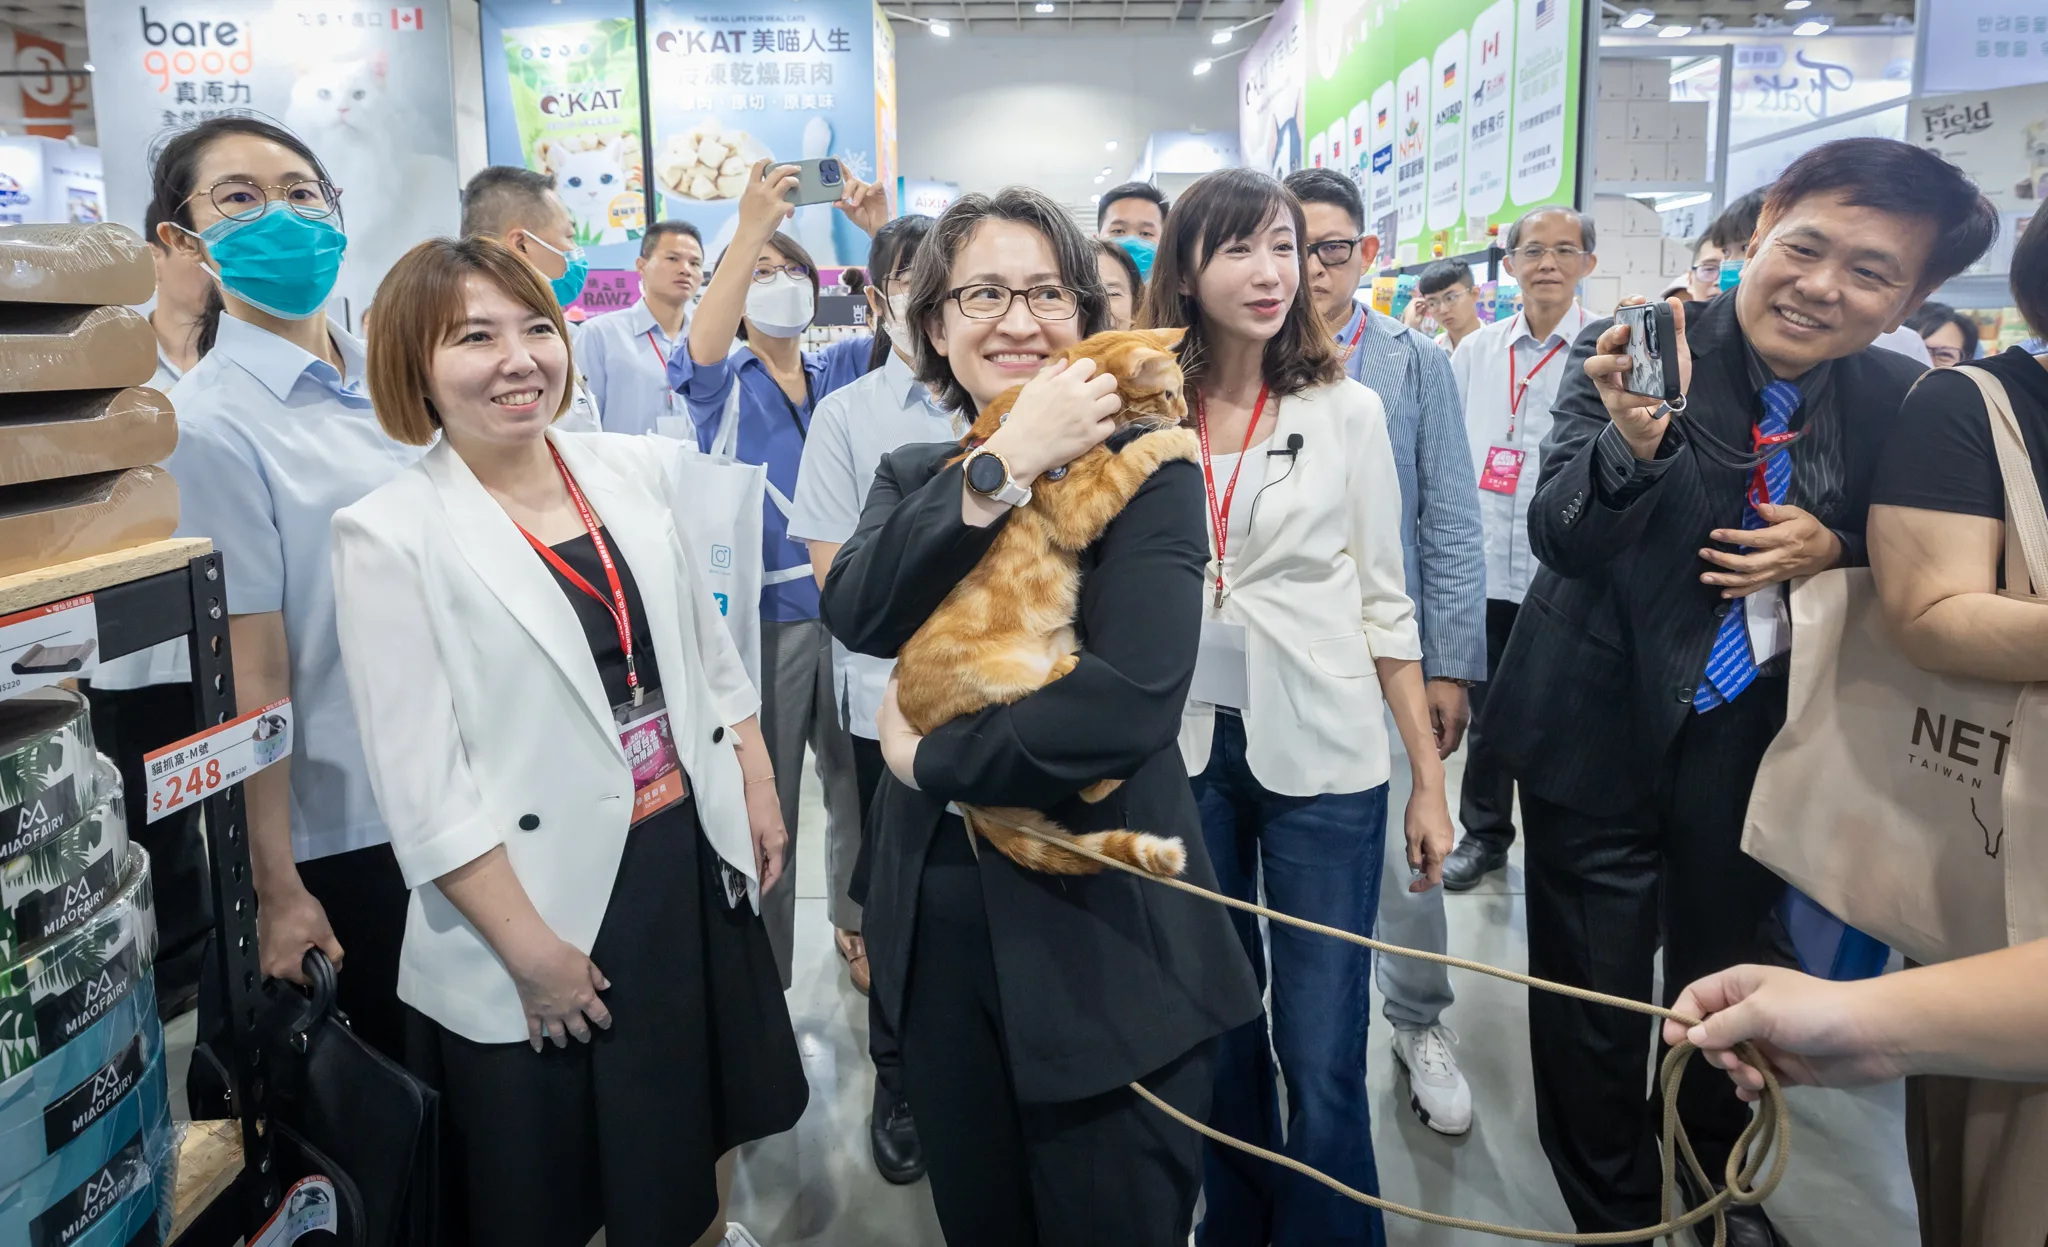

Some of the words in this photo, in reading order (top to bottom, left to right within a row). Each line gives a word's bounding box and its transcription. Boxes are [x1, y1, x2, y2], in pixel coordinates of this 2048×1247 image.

[139, 6, 240, 46] bare
[752, 28, 851, 53] 美喵人生
[143, 22, 253, 92] good
[175, 81, 251, 105] 真原力
[1924, 101, 1992, 133] Field
[584, 292, 632, 307] RAWZ
[151, 742, 209, 777] 貓抓窩-M號
[1908, 753, 1982, 789] TAIWAN
[152, 758, 222, 812] $248
[44, 887, 104, 937] MIAOFAIRY
[65, 977, 128, 1036] MIAOFAIRY
[72, 1071, 133, 1132] MIAOFAIRY
[61, 1171, 133, 1243] MIAOFAIRY
